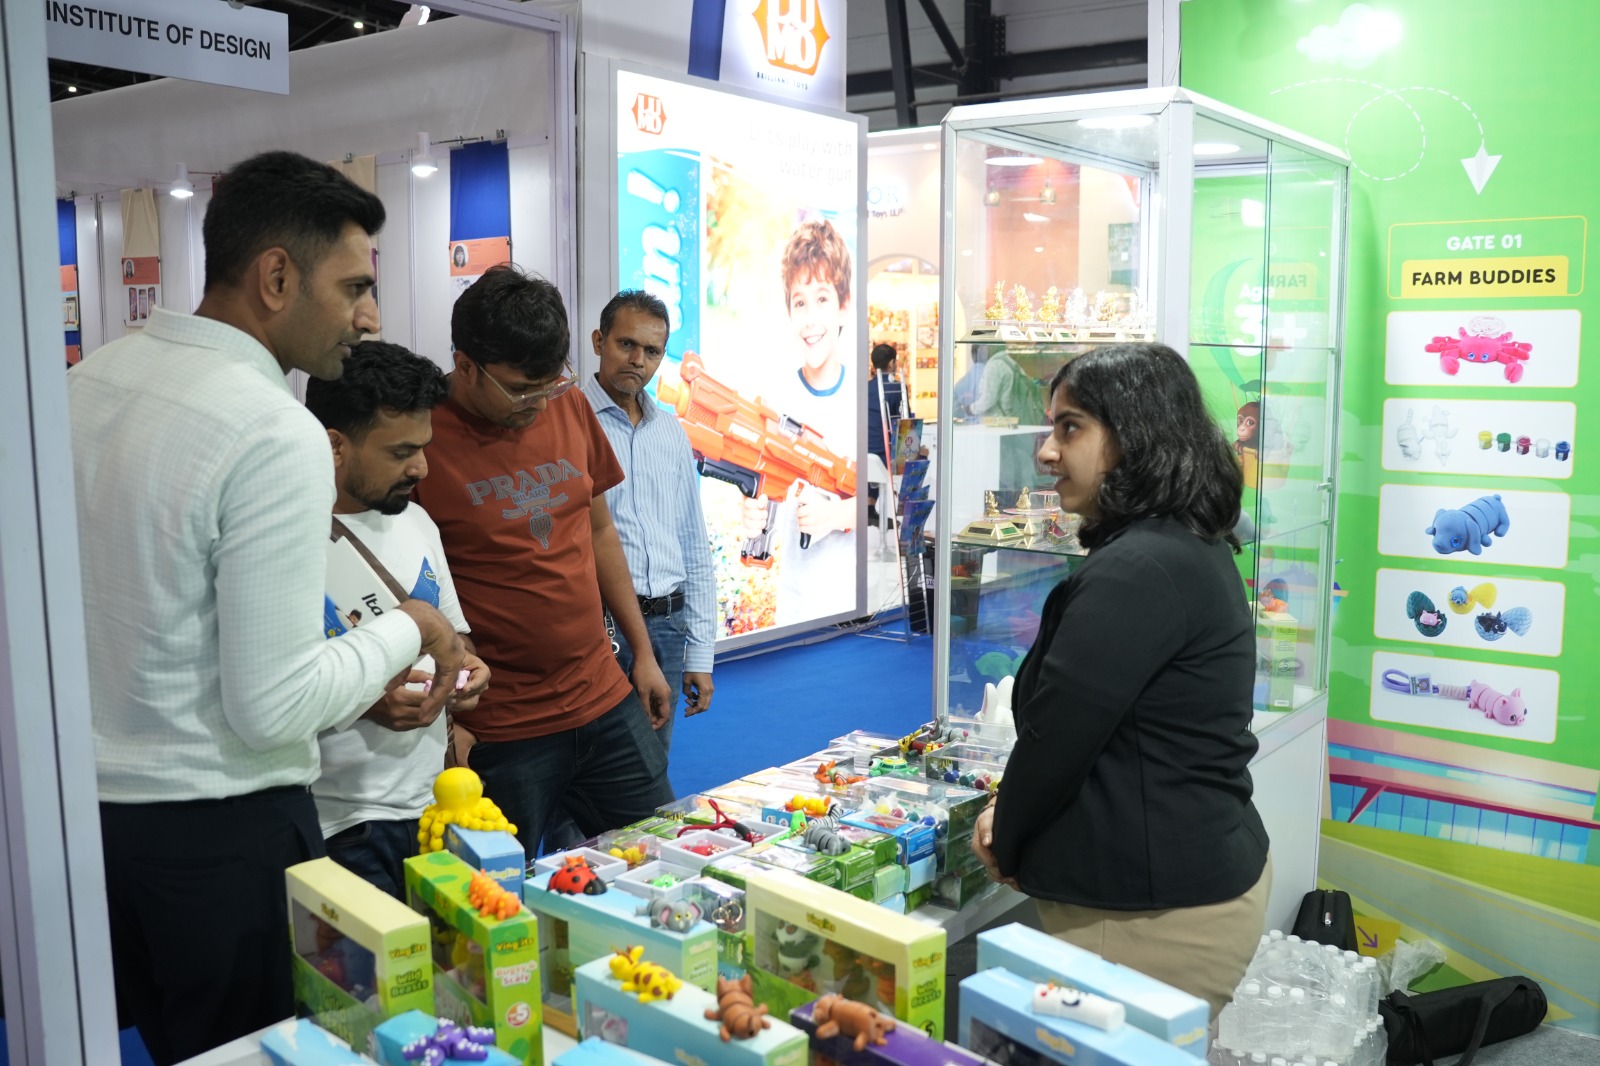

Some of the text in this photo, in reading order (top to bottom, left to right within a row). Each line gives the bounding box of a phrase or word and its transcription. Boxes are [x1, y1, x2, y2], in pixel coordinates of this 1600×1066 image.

[46, 1, 271, 60] INSTITUTE OF DESIGN
[822, 139, 852, 157] with
[1446, 234, 1522, 251] GATE 01
[1412, 268, 1556, 286] FARM BUDDIES
[466, 458, 583, 506] PRADA
